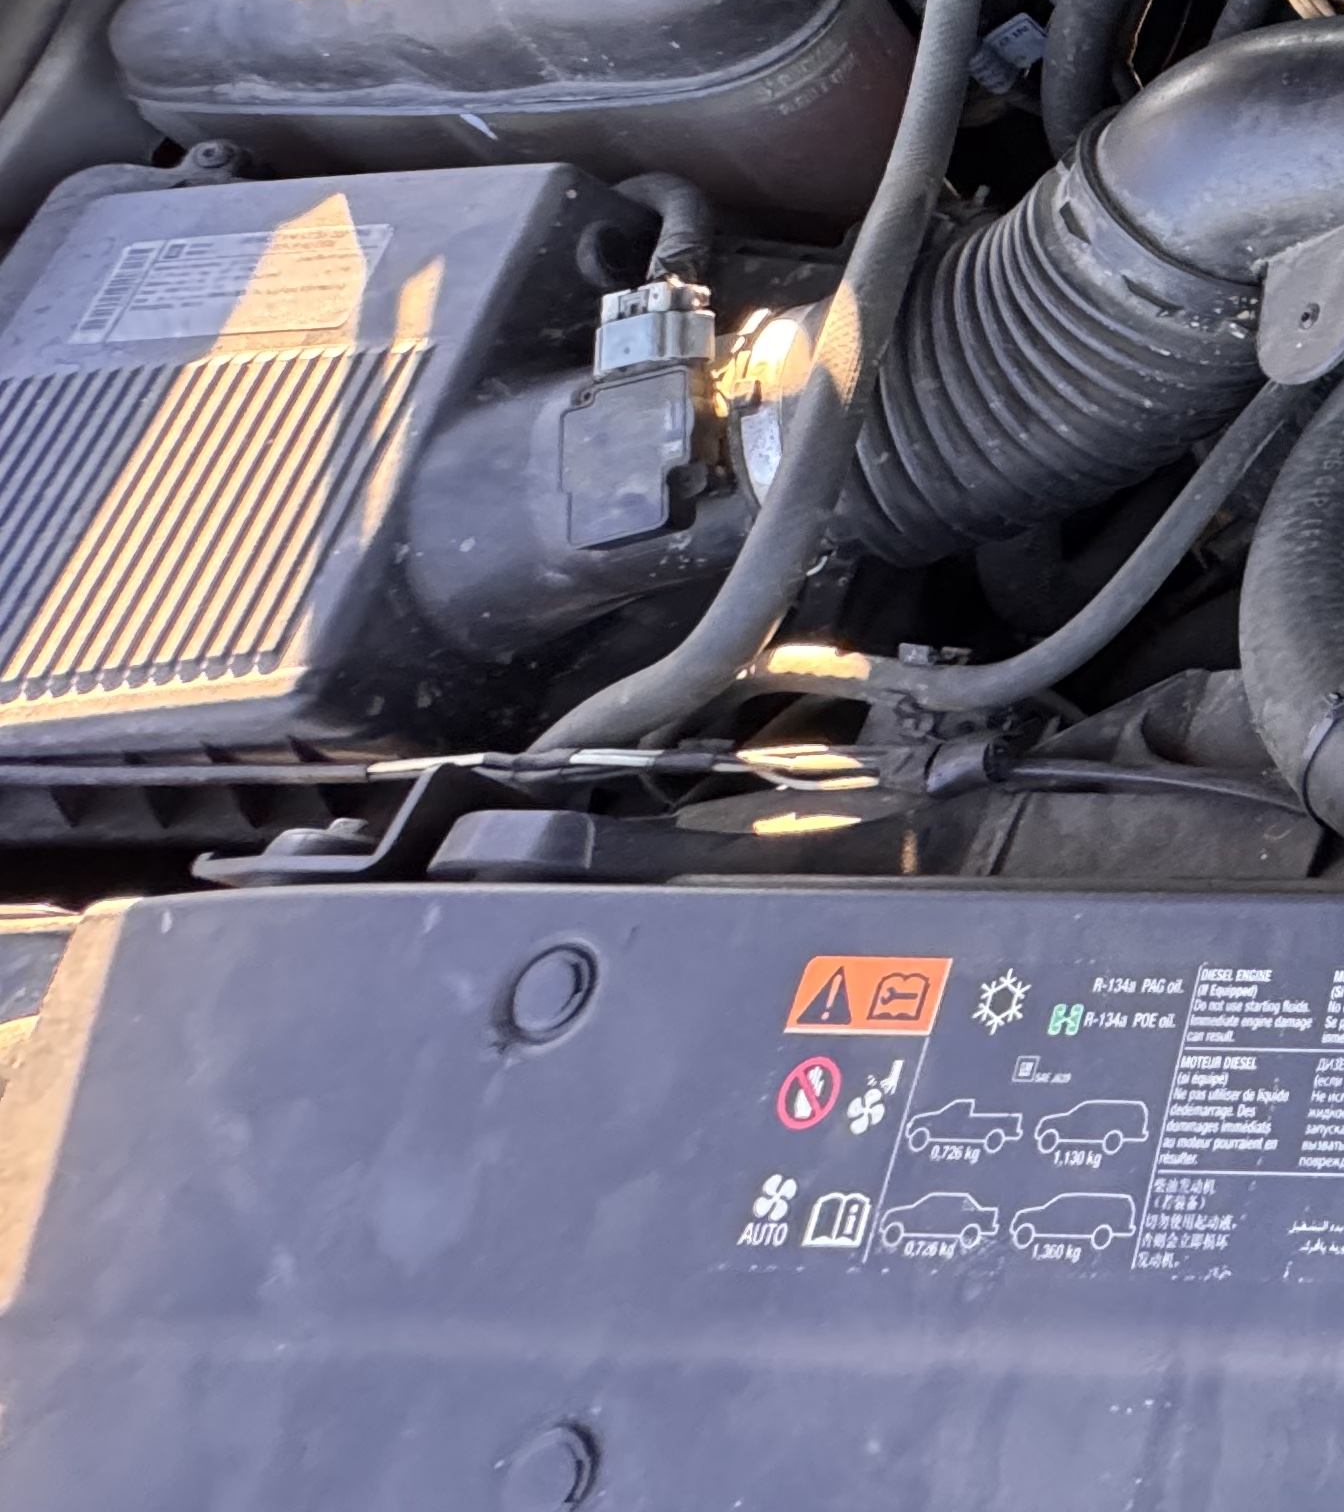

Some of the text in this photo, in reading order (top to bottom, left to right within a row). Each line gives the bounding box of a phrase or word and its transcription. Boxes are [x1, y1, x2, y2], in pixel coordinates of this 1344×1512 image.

[1201, 969, 1273, 983] DIESEL ENGINE
[1092, 978, 1136, 993] R-134a
[1141, 978, 1166, 993] PAG
[1226, 1003, 1243, 1012] use
[1328, 1002, 1341, 1013] No
[1083, 1011, 1127, 1027] R-134a
[1132, 1013, 1158, 1028] POE
[1325, 1017, 1337, 1028] Se
[1181, 1056, 1257, 1070] MOTEUR DIESEL
[1311, 1090, 1325, 1103] Не
[964, 1147, 981, 1164] kg
[1086, 1151, 1102, 1168] kg
[736, 1222, 788, 1247] AUTO
[1066, 1245, 1081, 1263] kg
